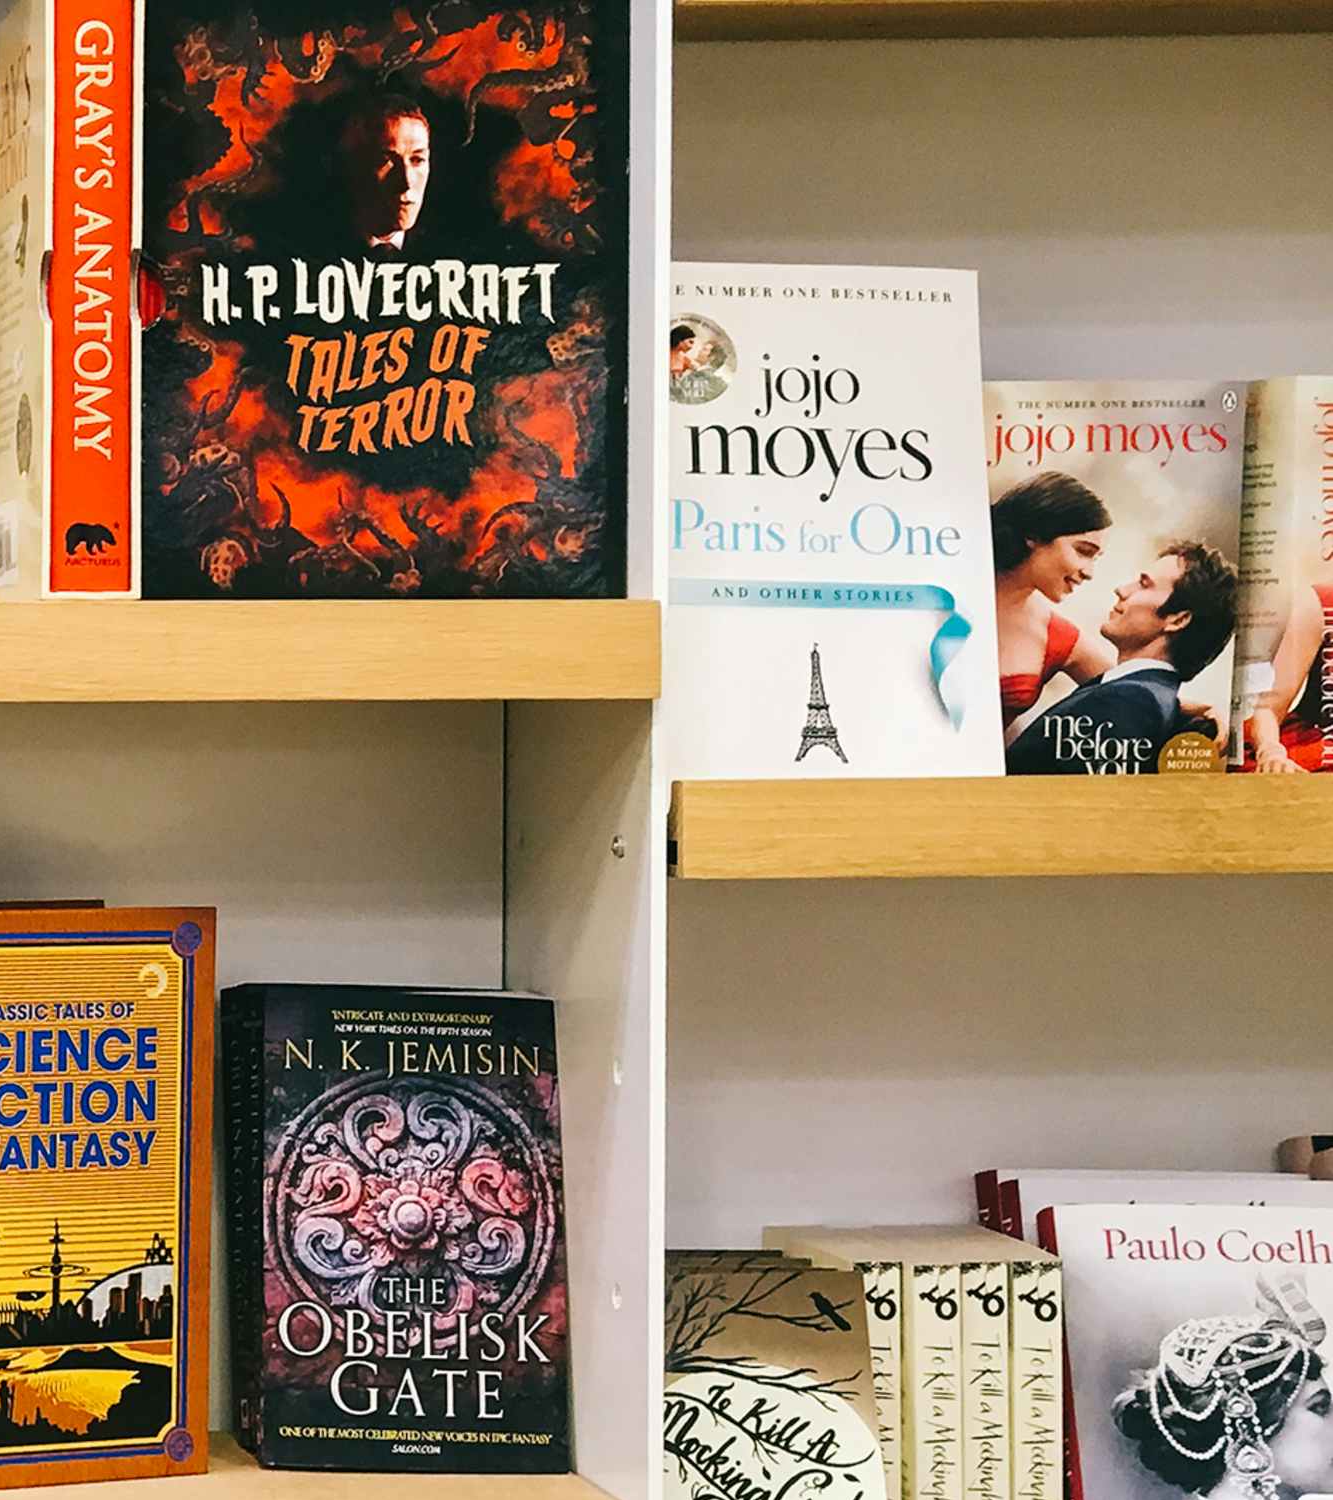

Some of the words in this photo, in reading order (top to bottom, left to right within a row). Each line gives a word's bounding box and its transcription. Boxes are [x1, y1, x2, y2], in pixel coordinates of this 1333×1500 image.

[74, 20, 115, 190] GRAY'S
[201, 261, 281, 324] H.P.
[294, 257, 562, 324] LOVECRAFT
[73, 206, 113, 459] ANATOMY
[285, 329, 411, 396] TALES
[429, 324, 490, 376] OF
[297, 378, 475, 454] TERROR
[755, 353, 860, 417] jojo
[685, 424, 933, 502] moyes
[671, 499, 786, 552] Paris
[799, 519, 844, 554] for
[850, 503, 961, 557] One
[712, 587, 750, 598] AND
[760, 588, 823, 601] OTHER
[834, 590, 914, 602] STORIES
[284, 1037, 326, 1070] N.
[342, 1039, 377, 1071] K.
[386, 1040, 541, 1077] JEMISIN
[1104, 1226, 1206, 1263] Paulo
[382, 1277, 446, 1305] THE
[278, 1302, 551, 1363] OBELISK
[330, 1361, 505, 1420] GATE
